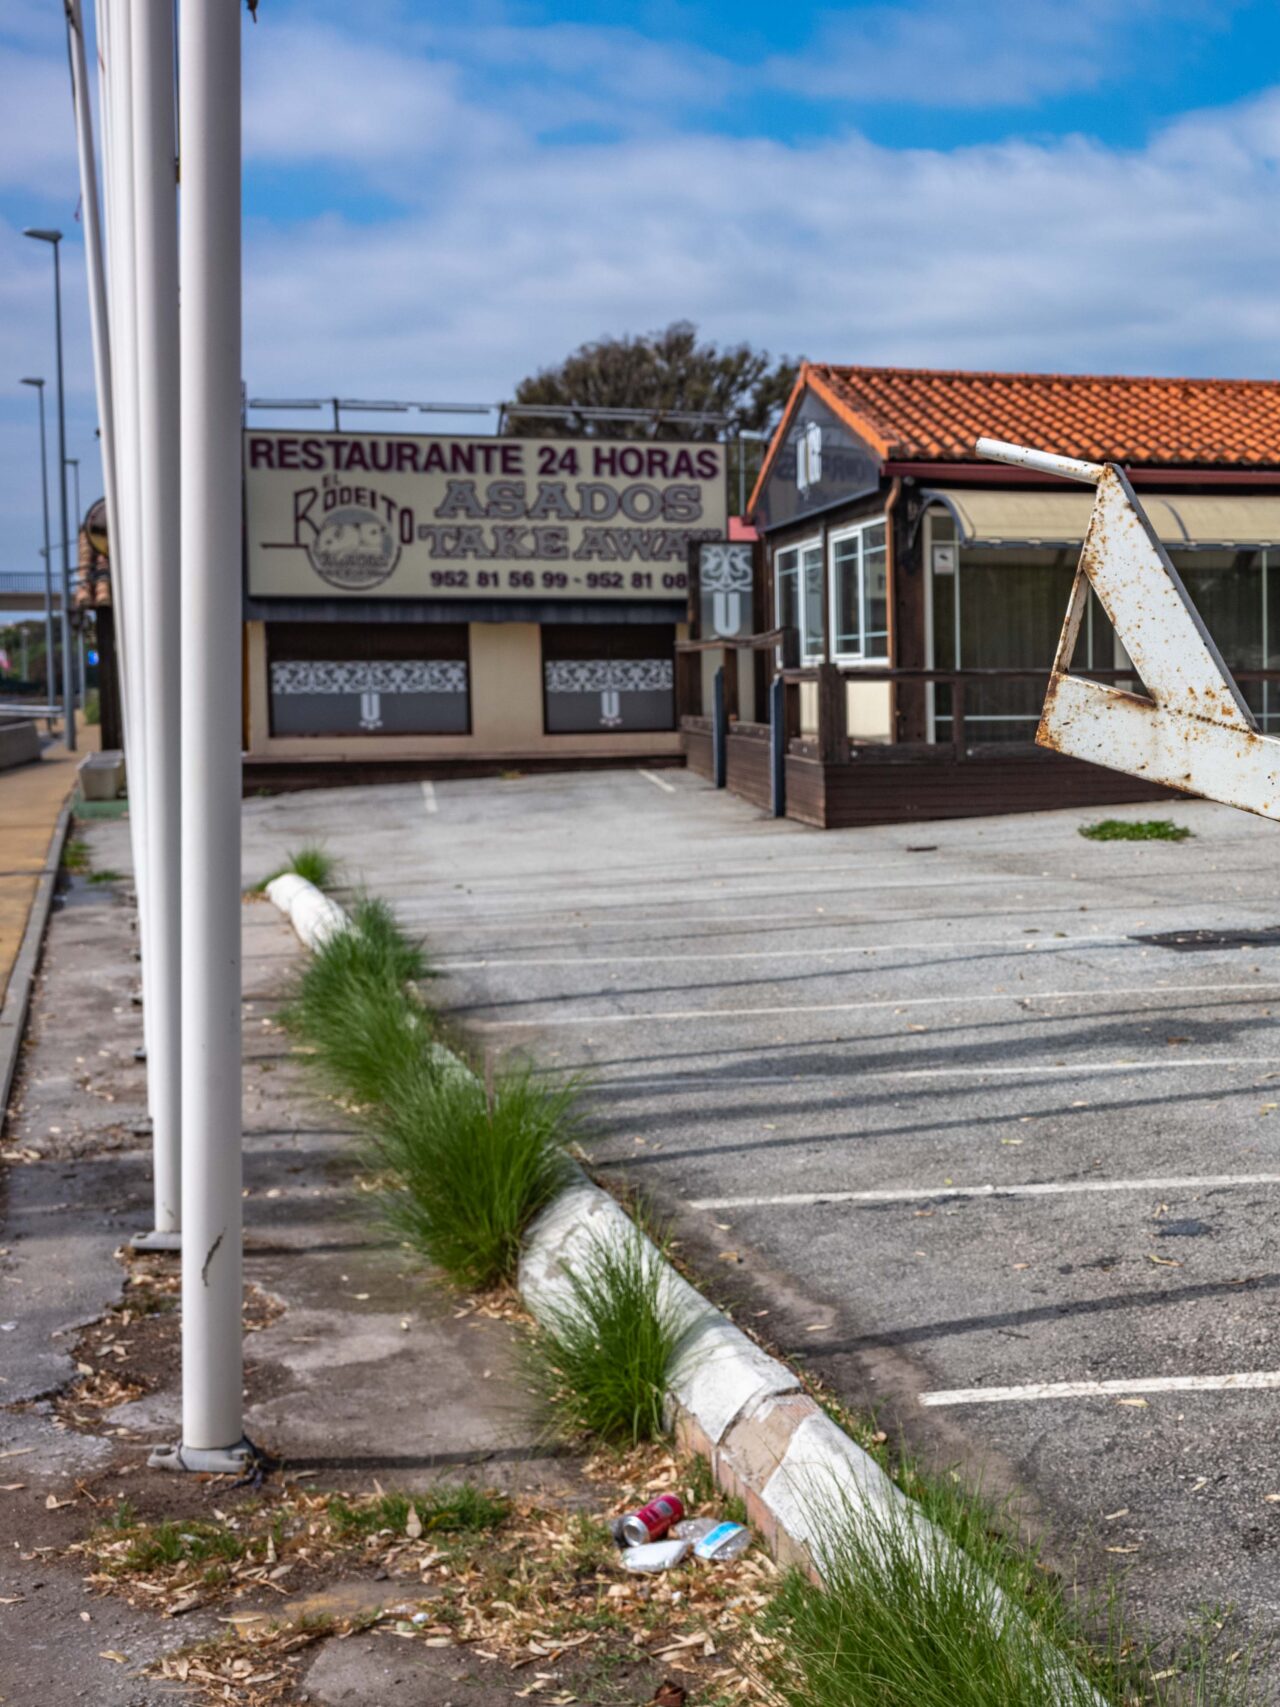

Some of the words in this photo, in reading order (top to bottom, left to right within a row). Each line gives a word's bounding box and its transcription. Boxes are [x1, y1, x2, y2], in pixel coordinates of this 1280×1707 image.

[249, 437, 524, 476] RESTAURANTE
[537, 447, 580, 477] 24
[593, 447, 719, 479] HORAS
[293, 485, 414, 546] RODEITO
[434, 479, 704, 523] ASADOS
[417, 524, 570, 561] TAKE
[430, 570, 469, 588] 952
[476, 571, 500, 588] 81
[508, 571, 534, 589] 56
[542, 571, 568, 589] 99
[586, 572, 624, 590] 952
[631, 573, 653, 590] 81
[662, 573, 688, 590] 08
